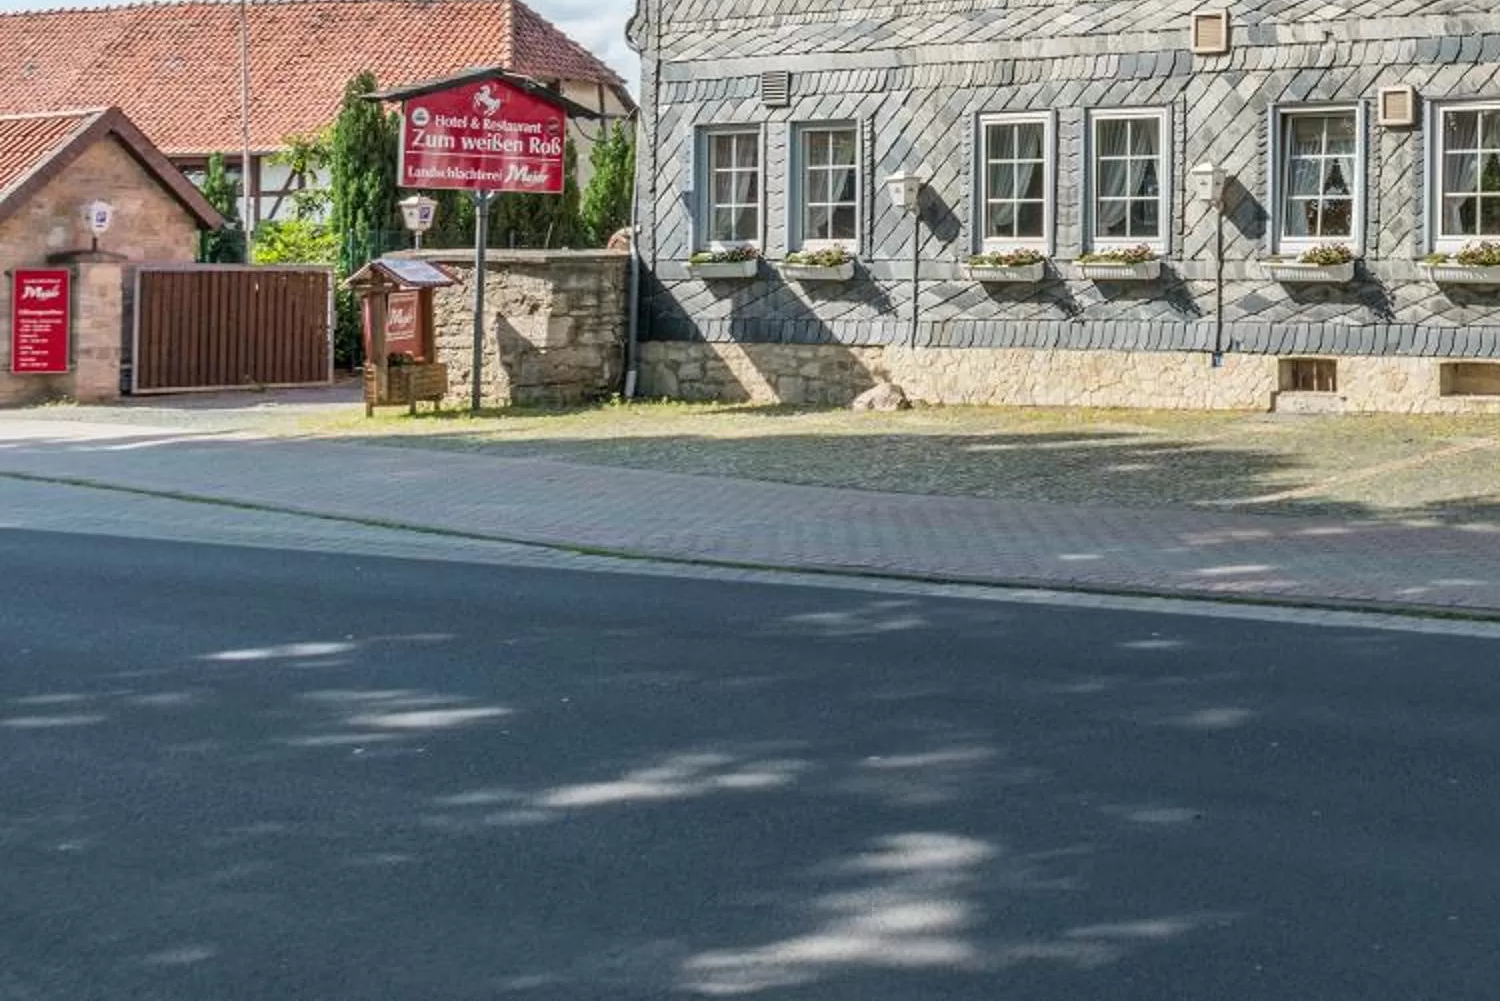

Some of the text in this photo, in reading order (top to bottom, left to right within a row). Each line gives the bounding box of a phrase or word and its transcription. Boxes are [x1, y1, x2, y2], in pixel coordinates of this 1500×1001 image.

[435, 114, 467, 129] Hotel
[470, 116, 480, 130] &
[483, 118, 542, 134] Restaurant
[411, 128, 561, 155] Zum weißen Roß
